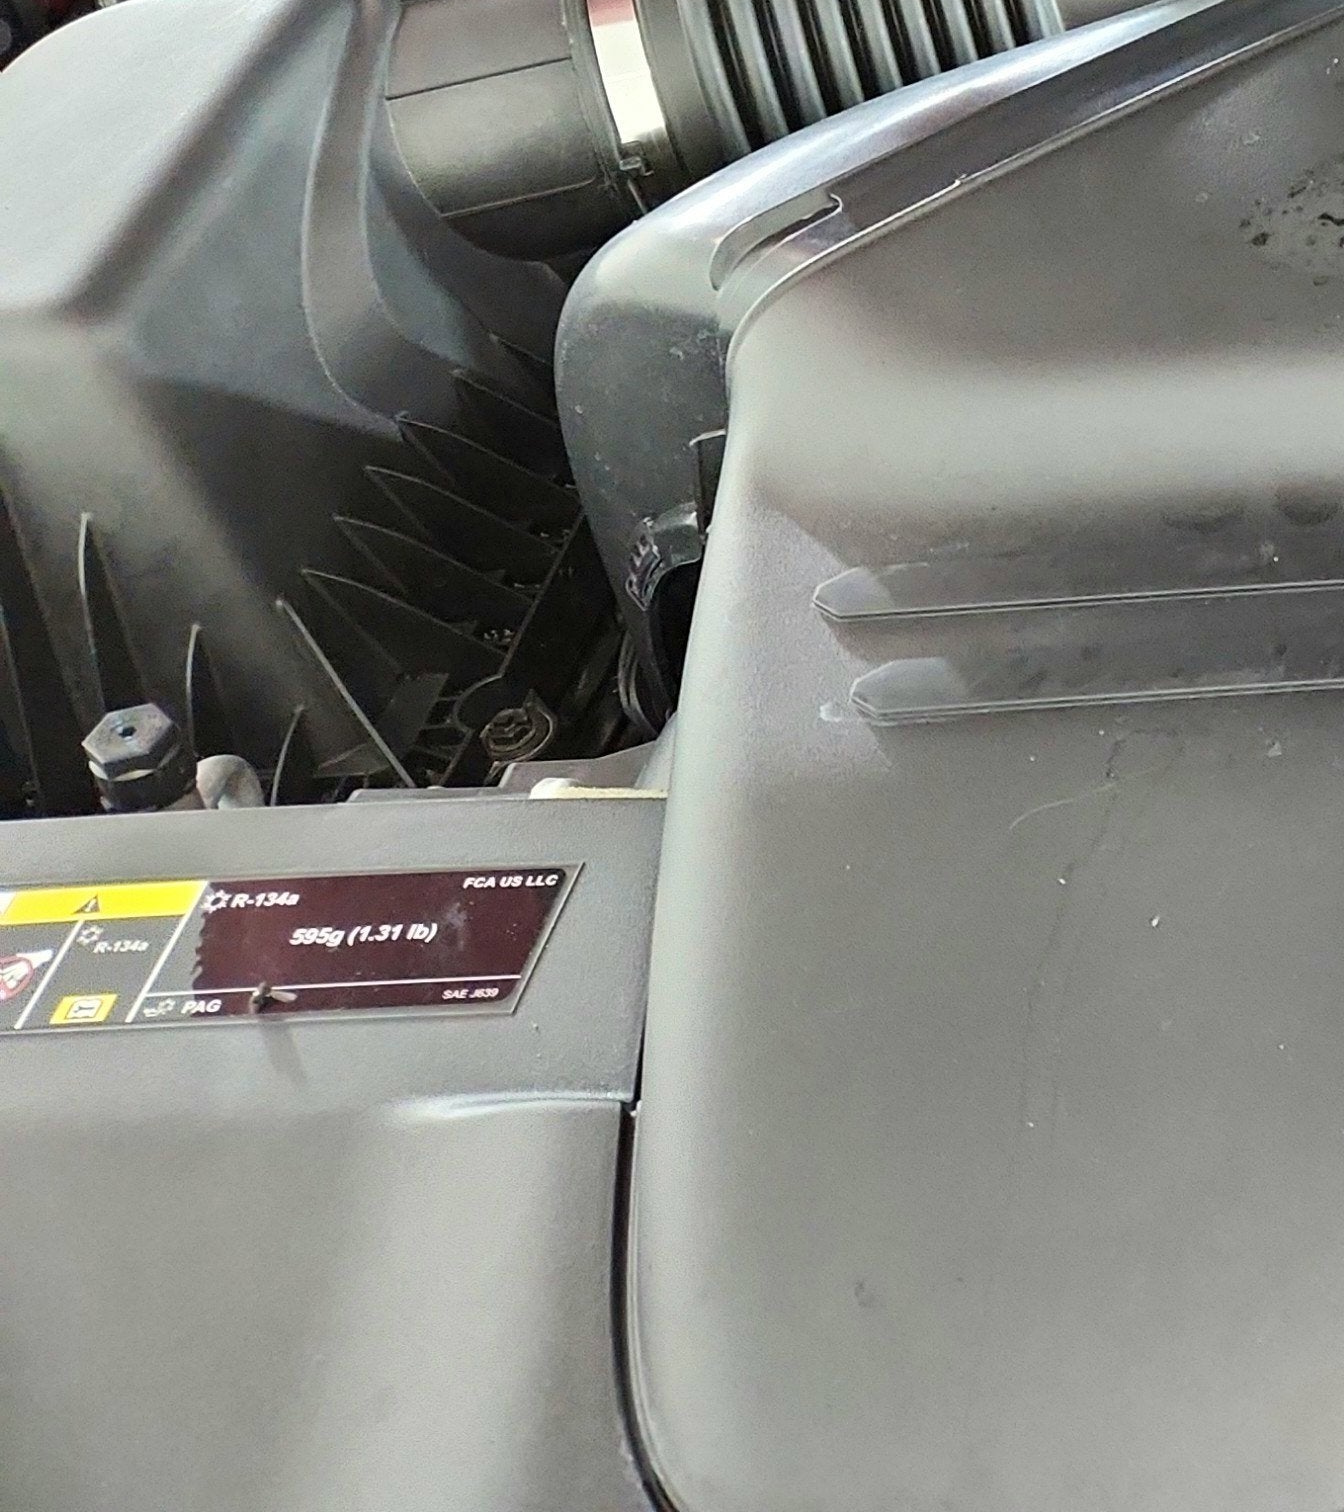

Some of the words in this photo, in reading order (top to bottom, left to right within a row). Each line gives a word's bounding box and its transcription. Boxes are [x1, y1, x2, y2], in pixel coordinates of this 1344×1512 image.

[463, 875, 497, 890] FCA
[500, 874, 523, 889] US
[525, 872, 559, 887] LLC
[229, 891, 301, 909] R-134a
[289, 927, 345, 948] 595g
[346, 925, 404, 947] (1.31
[405, 921, 438, 944] lb)
[93, 938, 149, 955] R-134a
[441, 988, 469, 1001] SAE
[181, 998, 222, 1015] PAG
